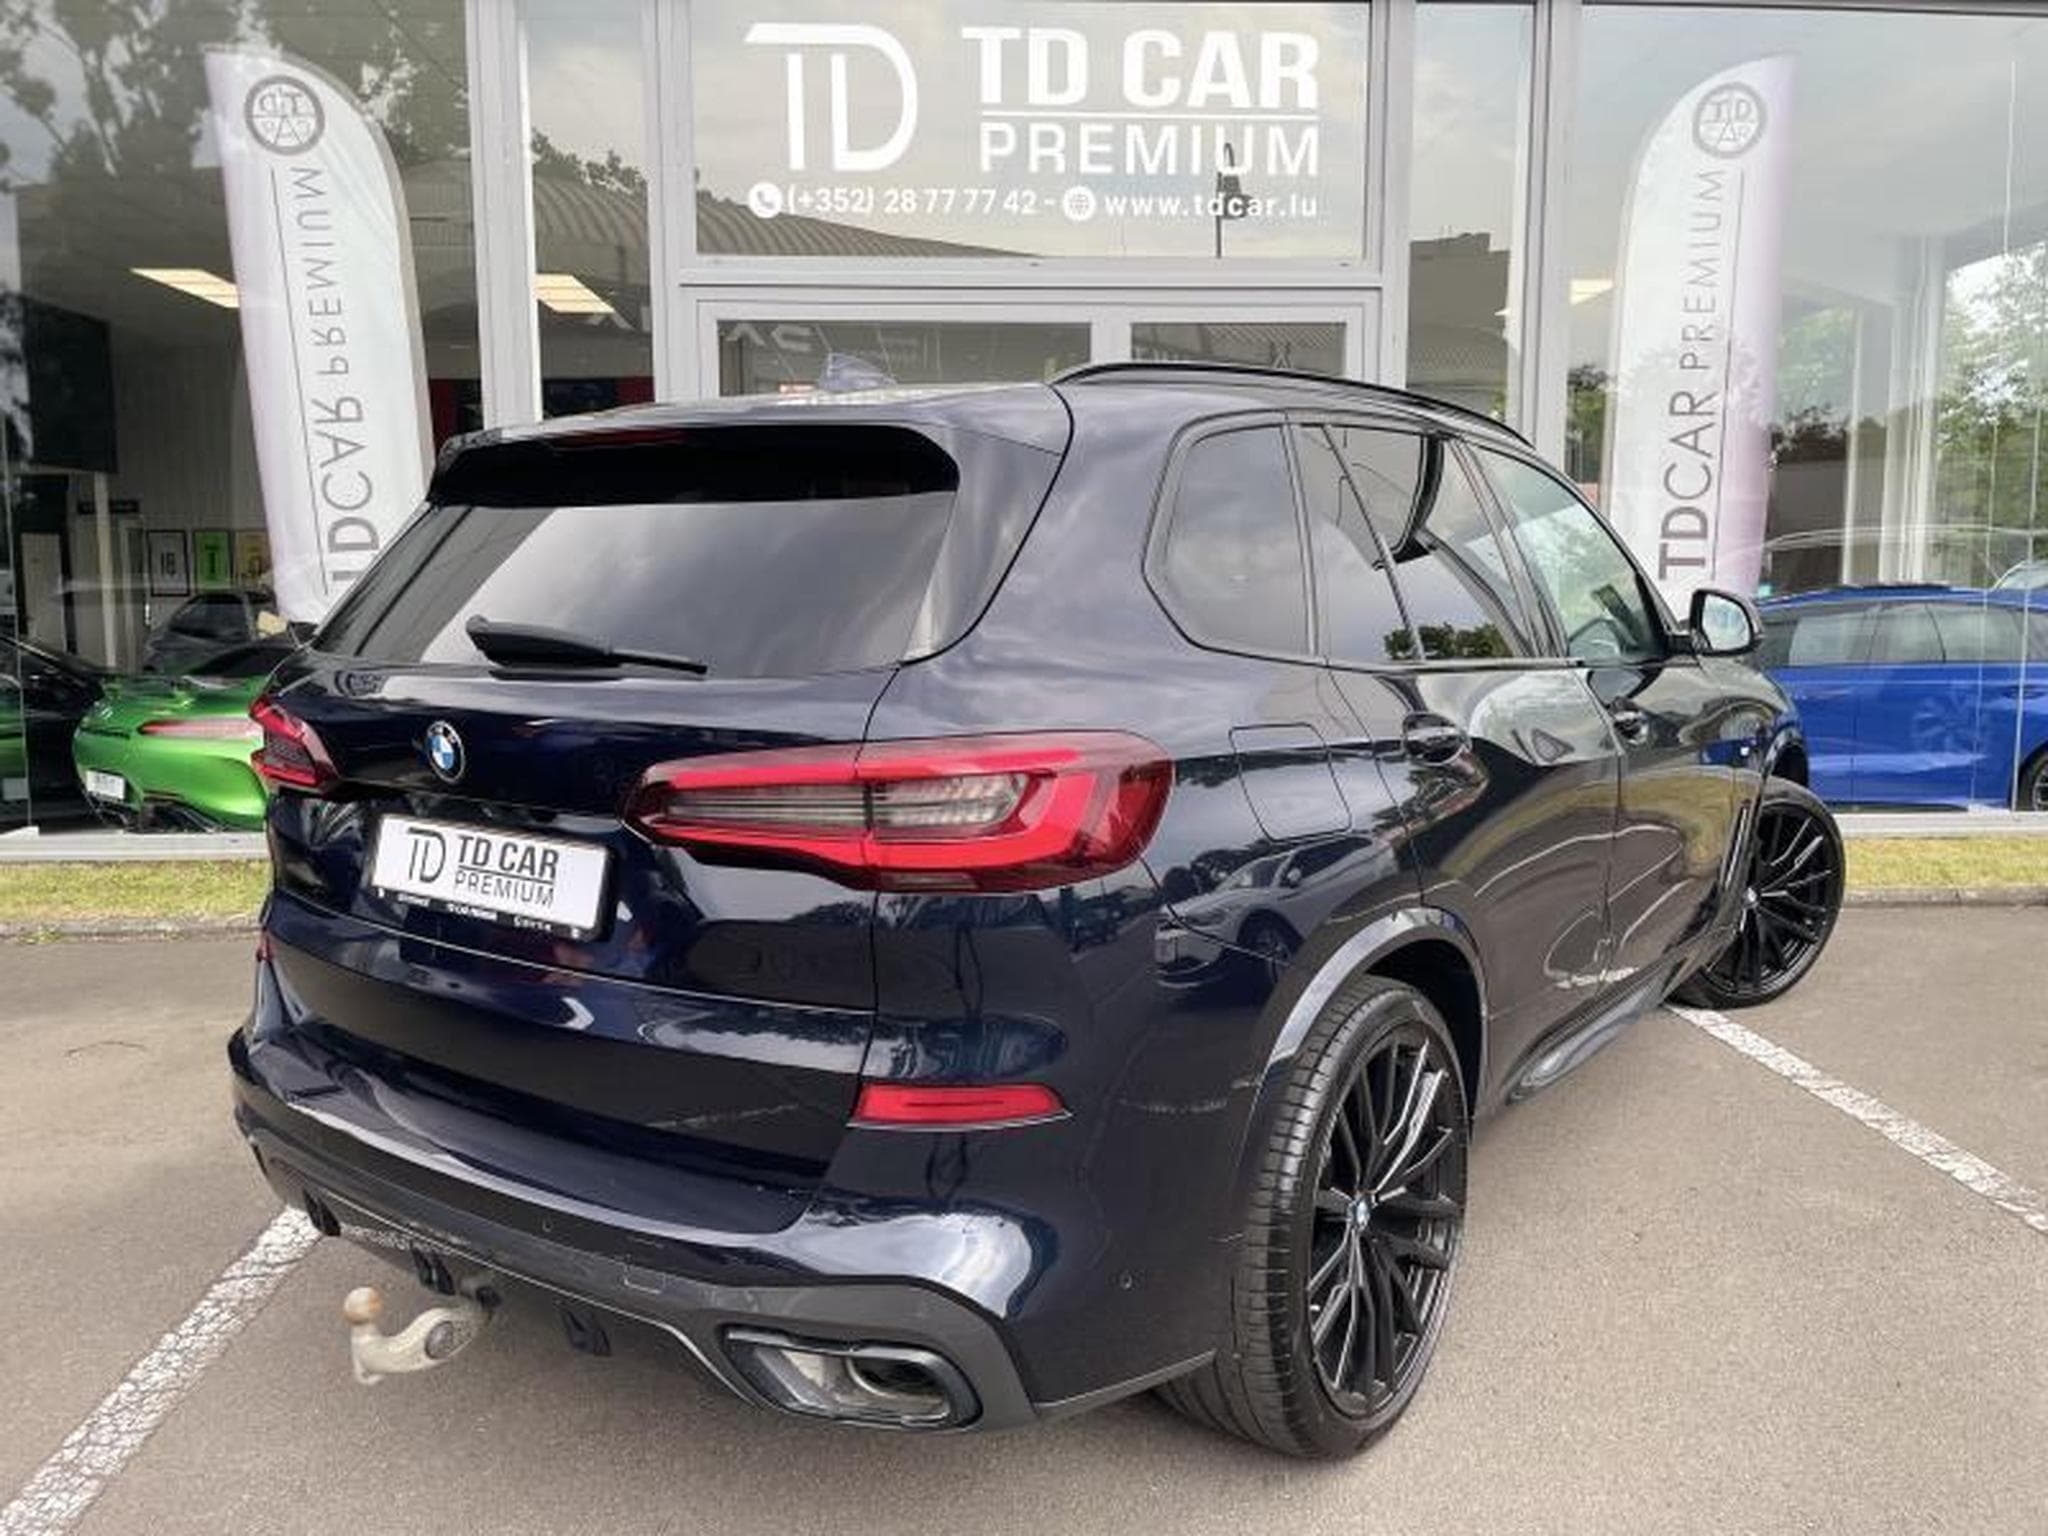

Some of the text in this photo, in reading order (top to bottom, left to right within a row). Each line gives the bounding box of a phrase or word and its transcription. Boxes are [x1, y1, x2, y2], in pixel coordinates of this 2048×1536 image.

[961, 27, 1320, 109] TD CAR
[979, 121, 1320, 177] PREMIUM
[786, 184, 875, 214] (+352)
[883, 188, 918, 213] 28
[925, 189, 956, 214] 77
[964, 189, 997, 214] 77
[1003, 190, 1038, 215] 42
[1104, 191, 1317, 218] www.tdcar.lu
[1657, 170, 1726, 581] TDCAR PREMIUM
[457, 834, 560, 879] TD CAR
[454, 869, 554, 910] PREMIUM
